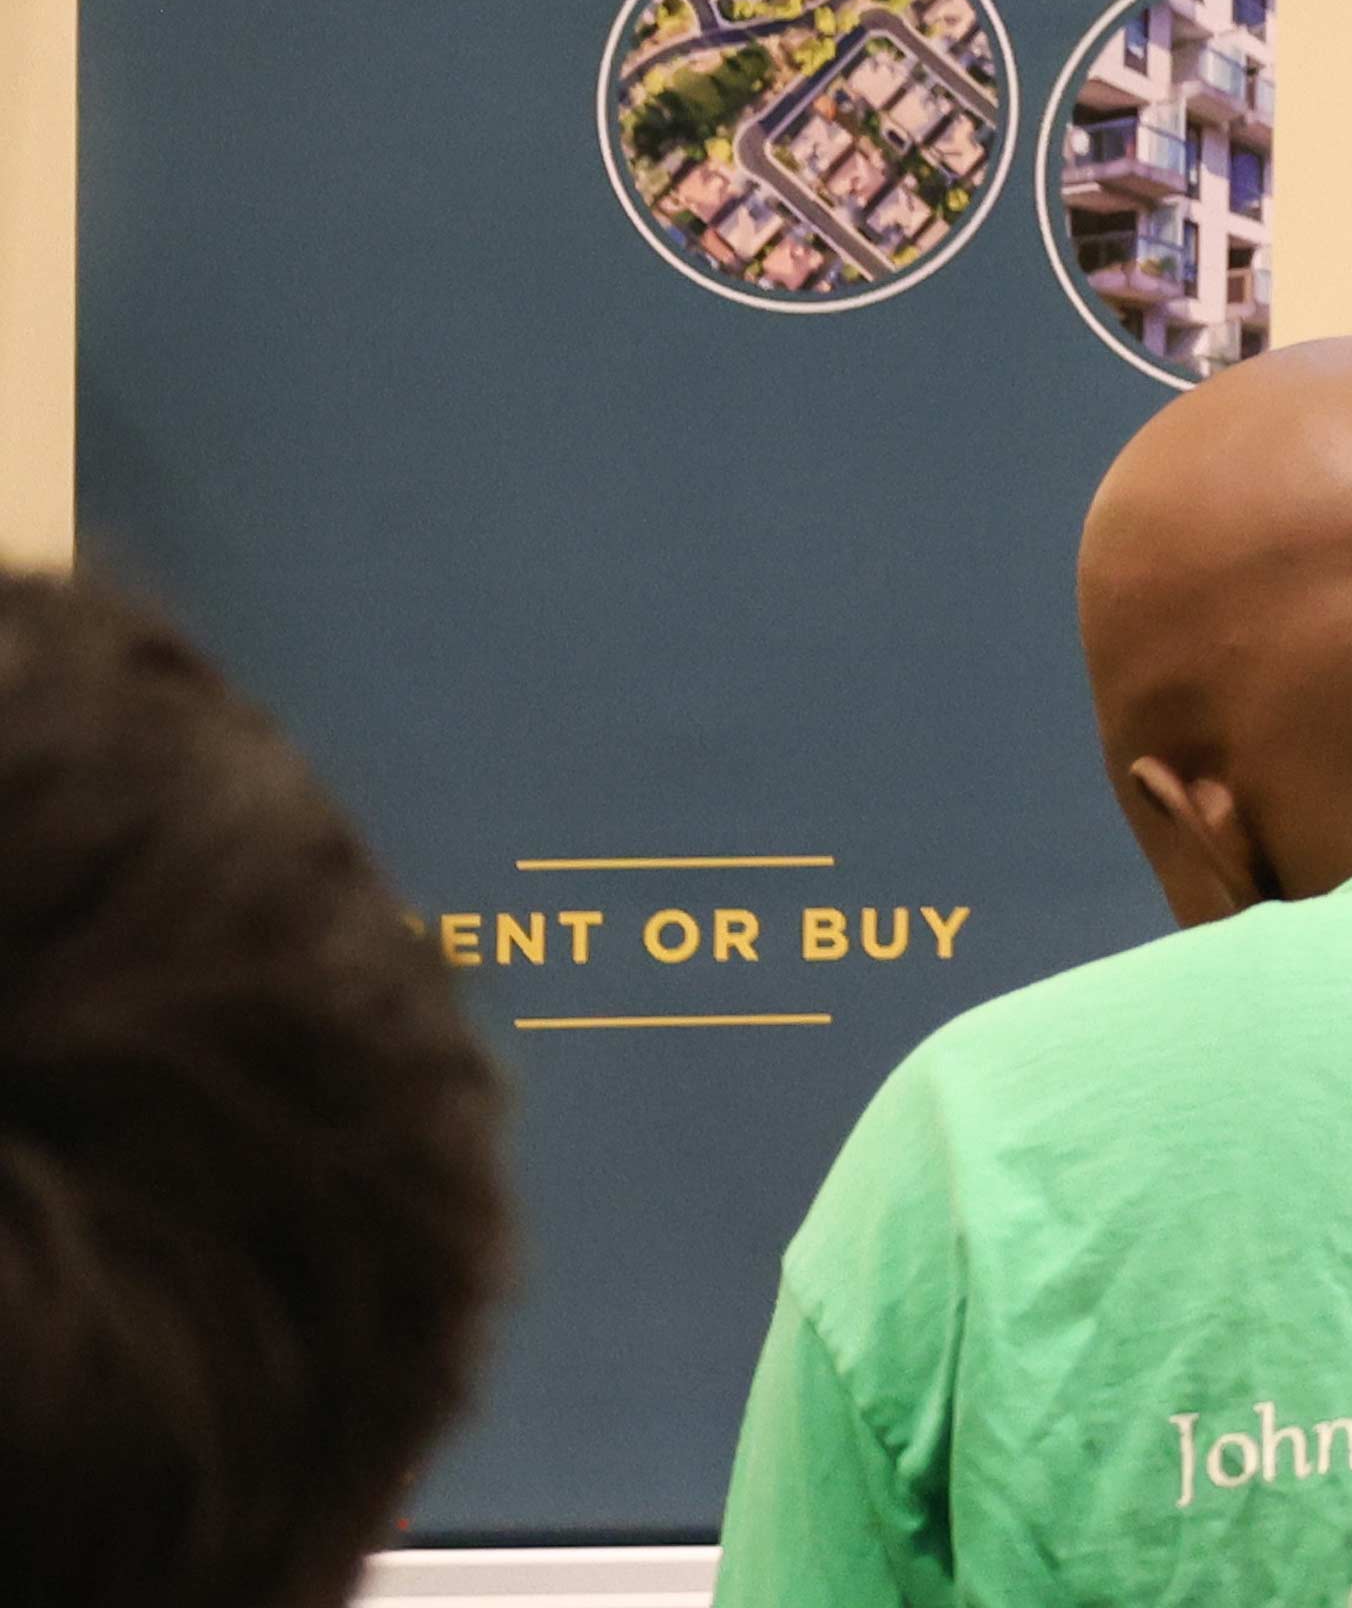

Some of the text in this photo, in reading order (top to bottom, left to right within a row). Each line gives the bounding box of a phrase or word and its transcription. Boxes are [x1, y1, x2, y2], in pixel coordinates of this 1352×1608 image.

[405, 905, 971, 969] ENT OR BUY
